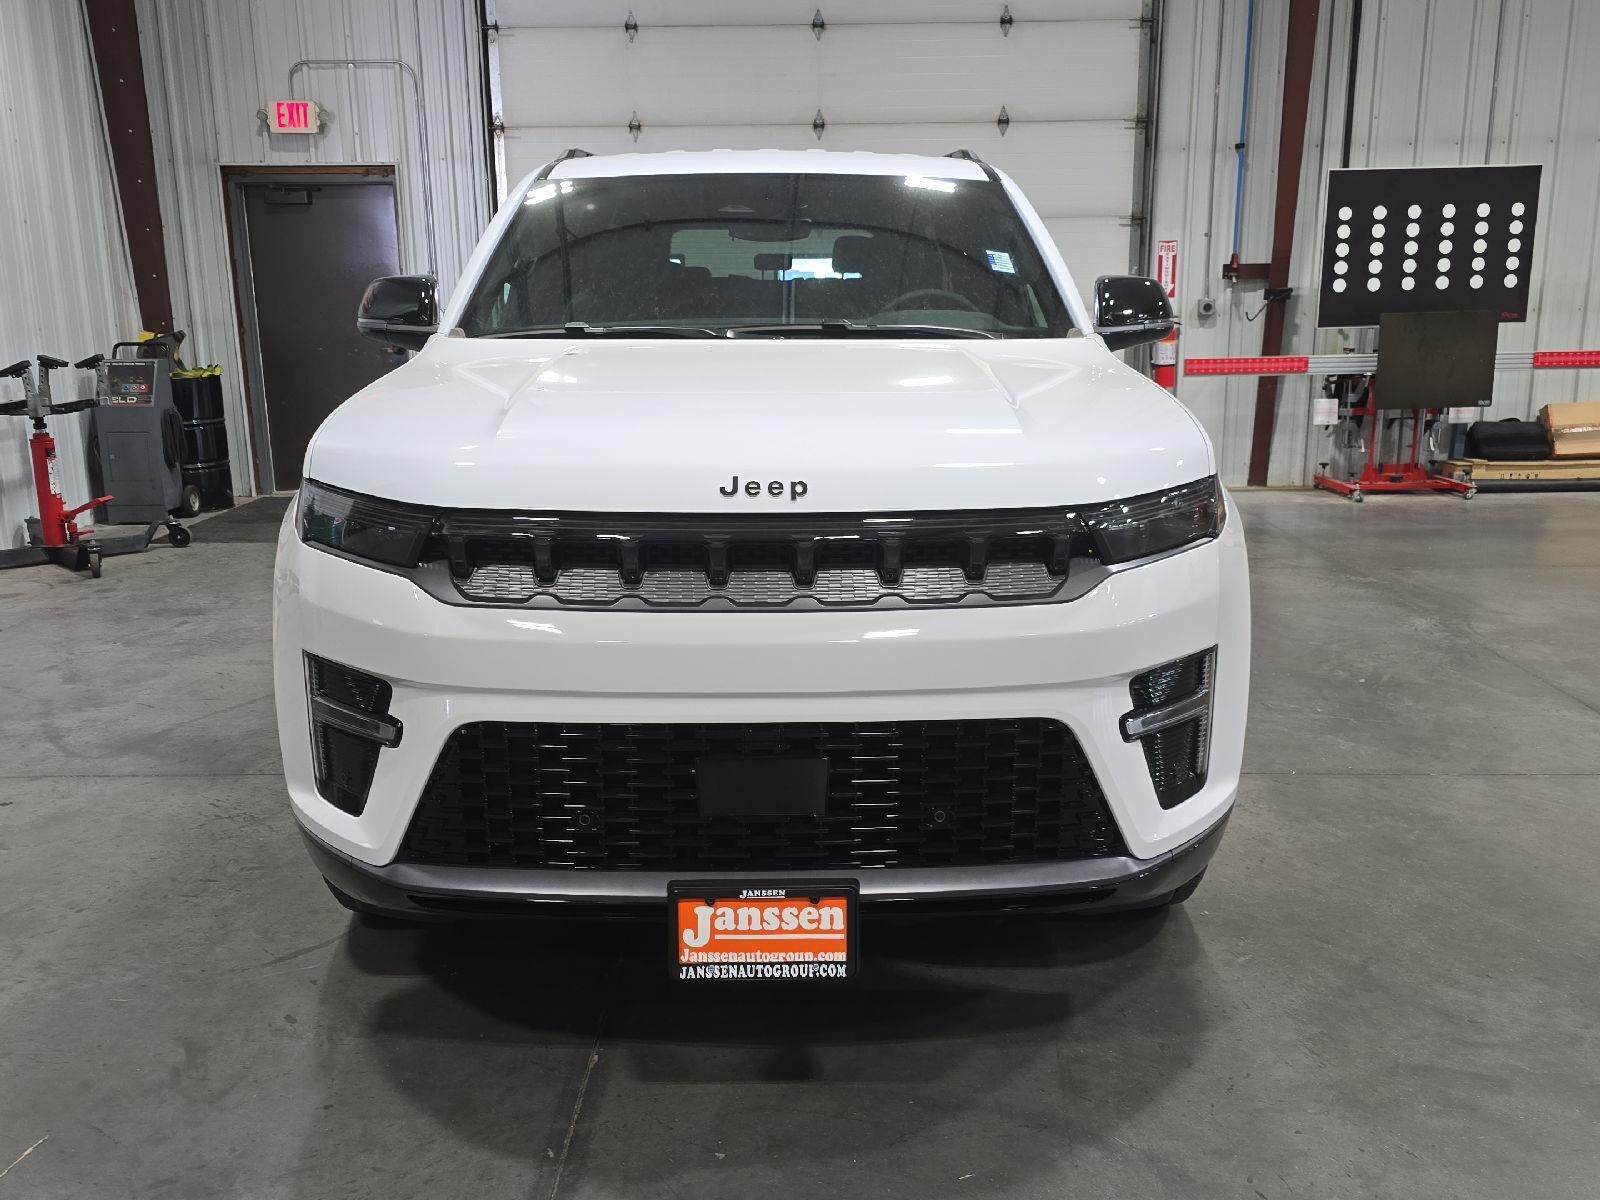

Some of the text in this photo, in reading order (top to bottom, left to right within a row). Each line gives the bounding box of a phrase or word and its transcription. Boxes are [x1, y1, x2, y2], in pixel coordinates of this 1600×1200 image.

[276, 102, 309, 128] EXIT
[719, 475, 808, 501] Jeep
[739, 889, 786, 899] JANSSEN
[682, 906, 845, 947] Janssen
[679, 964, 847, 979] JANSSENAUTOGROUP.COM
